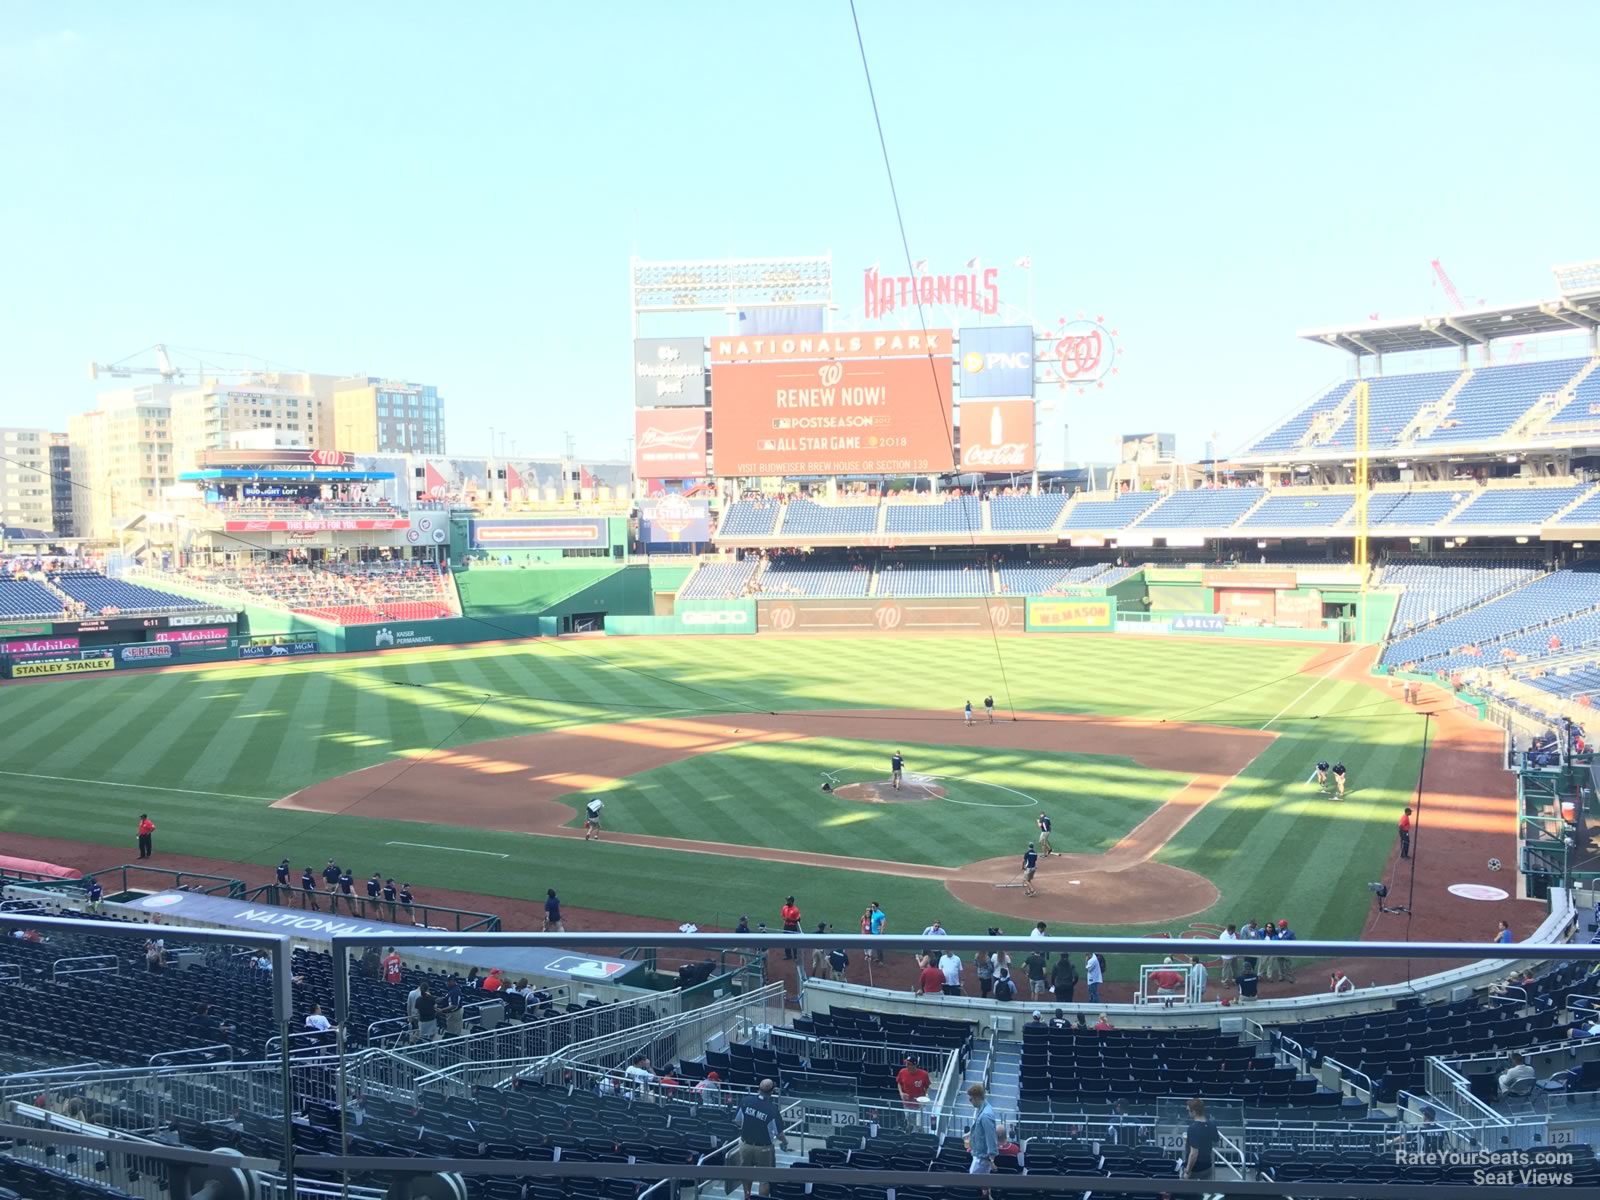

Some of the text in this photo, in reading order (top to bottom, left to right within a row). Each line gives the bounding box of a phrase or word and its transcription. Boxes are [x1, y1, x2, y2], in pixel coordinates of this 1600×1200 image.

[864, 268, 998, 319] NATIONALS
[719, 334, 938, 355] NATIONALS PARK
[986, 352, 1030, 369] PNC
[776, 386, 886, 408] RENEW NOW!
[791, 415, 873, 429] POSTSEASON
[776, 436, 907, 451] ALL STAR GAME 2018
[737, 460, 928, 473] VISIT BUDWEISER BREW HOUSE OR SECTION 139
[287, 520, 303, 530] THIS
[304, 520, 326, 530] BUD'S
[327, 520, 341, 529] FOR
[206, 613, 238, 624] FAN
[1186, 618, 1223, 629] DELTA
[396, 630, 414, 638] KAISER
[294, 642, 314, 650] MGM
[16, 664, 62, 675] STANLEY
[66, 660, 110, 671] STANLEY
[234, 908, 394, 934] NATIONAL
[389, 963, 400, 974] 34
[745, 1107, 768, 1120] ASK ME!
[834, 1113, 855, 1126] 120
[1160, 1136, 1184, 1148] 120
[1551, 1132, 1572, 1144] 121
